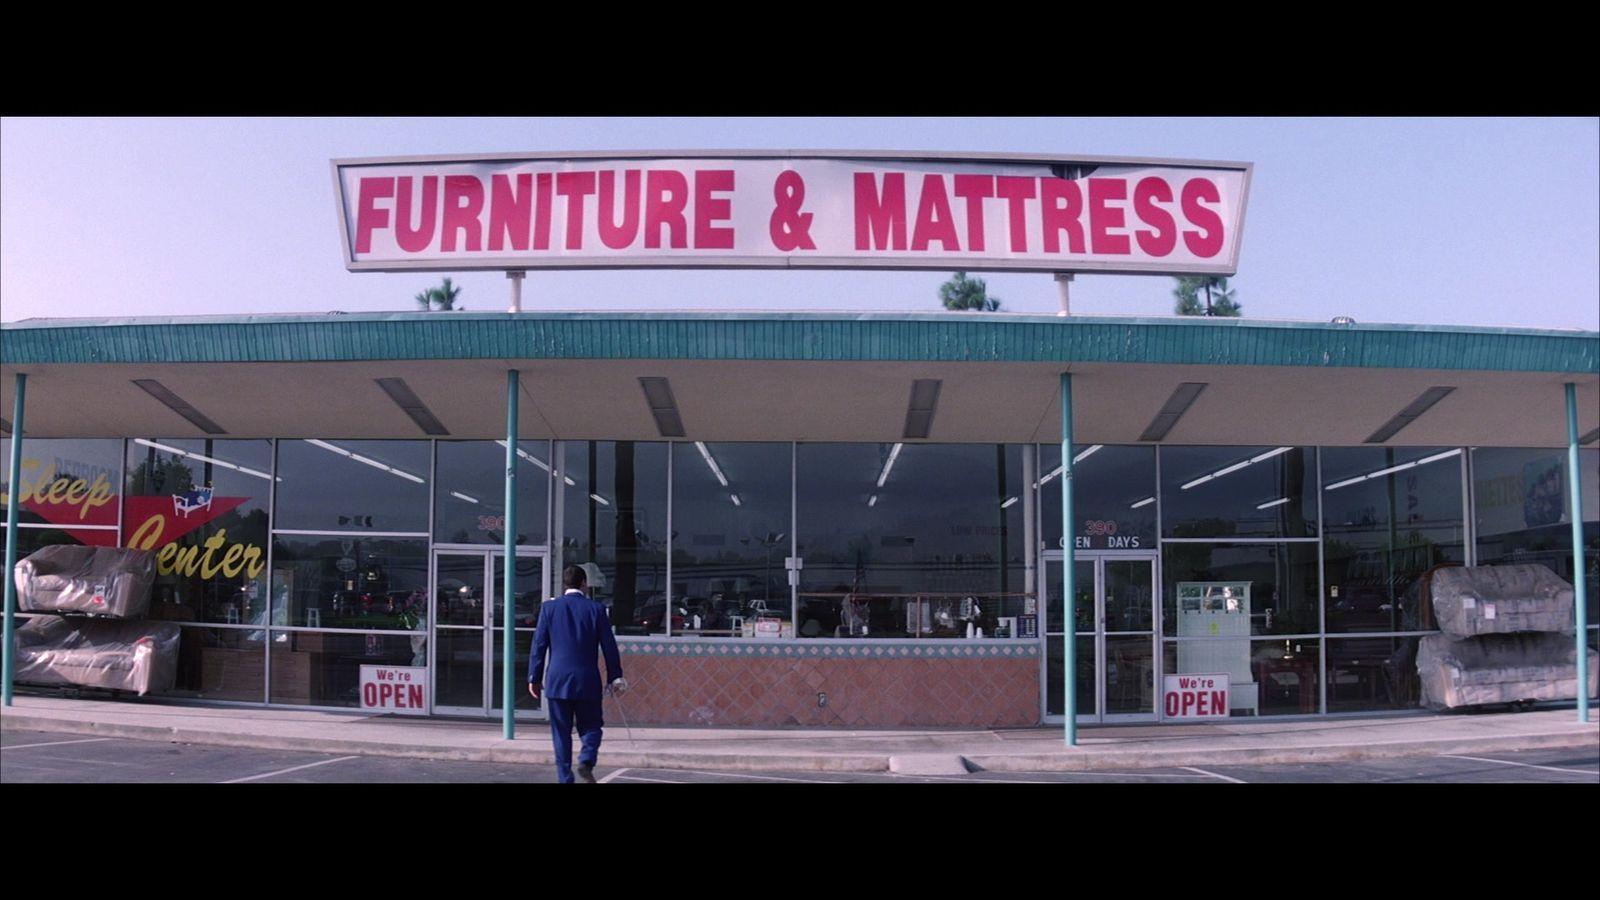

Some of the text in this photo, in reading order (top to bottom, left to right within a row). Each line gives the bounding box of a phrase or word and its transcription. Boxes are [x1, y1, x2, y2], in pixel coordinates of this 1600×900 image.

[354, 168, 1225, 259] FURNITURE & MATTRESS
[1085, 519, 1117, 536] 390
[127, 514, 267, 580] Center
[1059, 536, 1091, 548] OEN
[1108, 536, 1140, 548] DAYS
[376, 669, 411, 682] We're
[1178, 677, 1214, 689] We're
[363, 682, 424, 709] OPEN
[1165, 690, 1226, 717] OPEN
